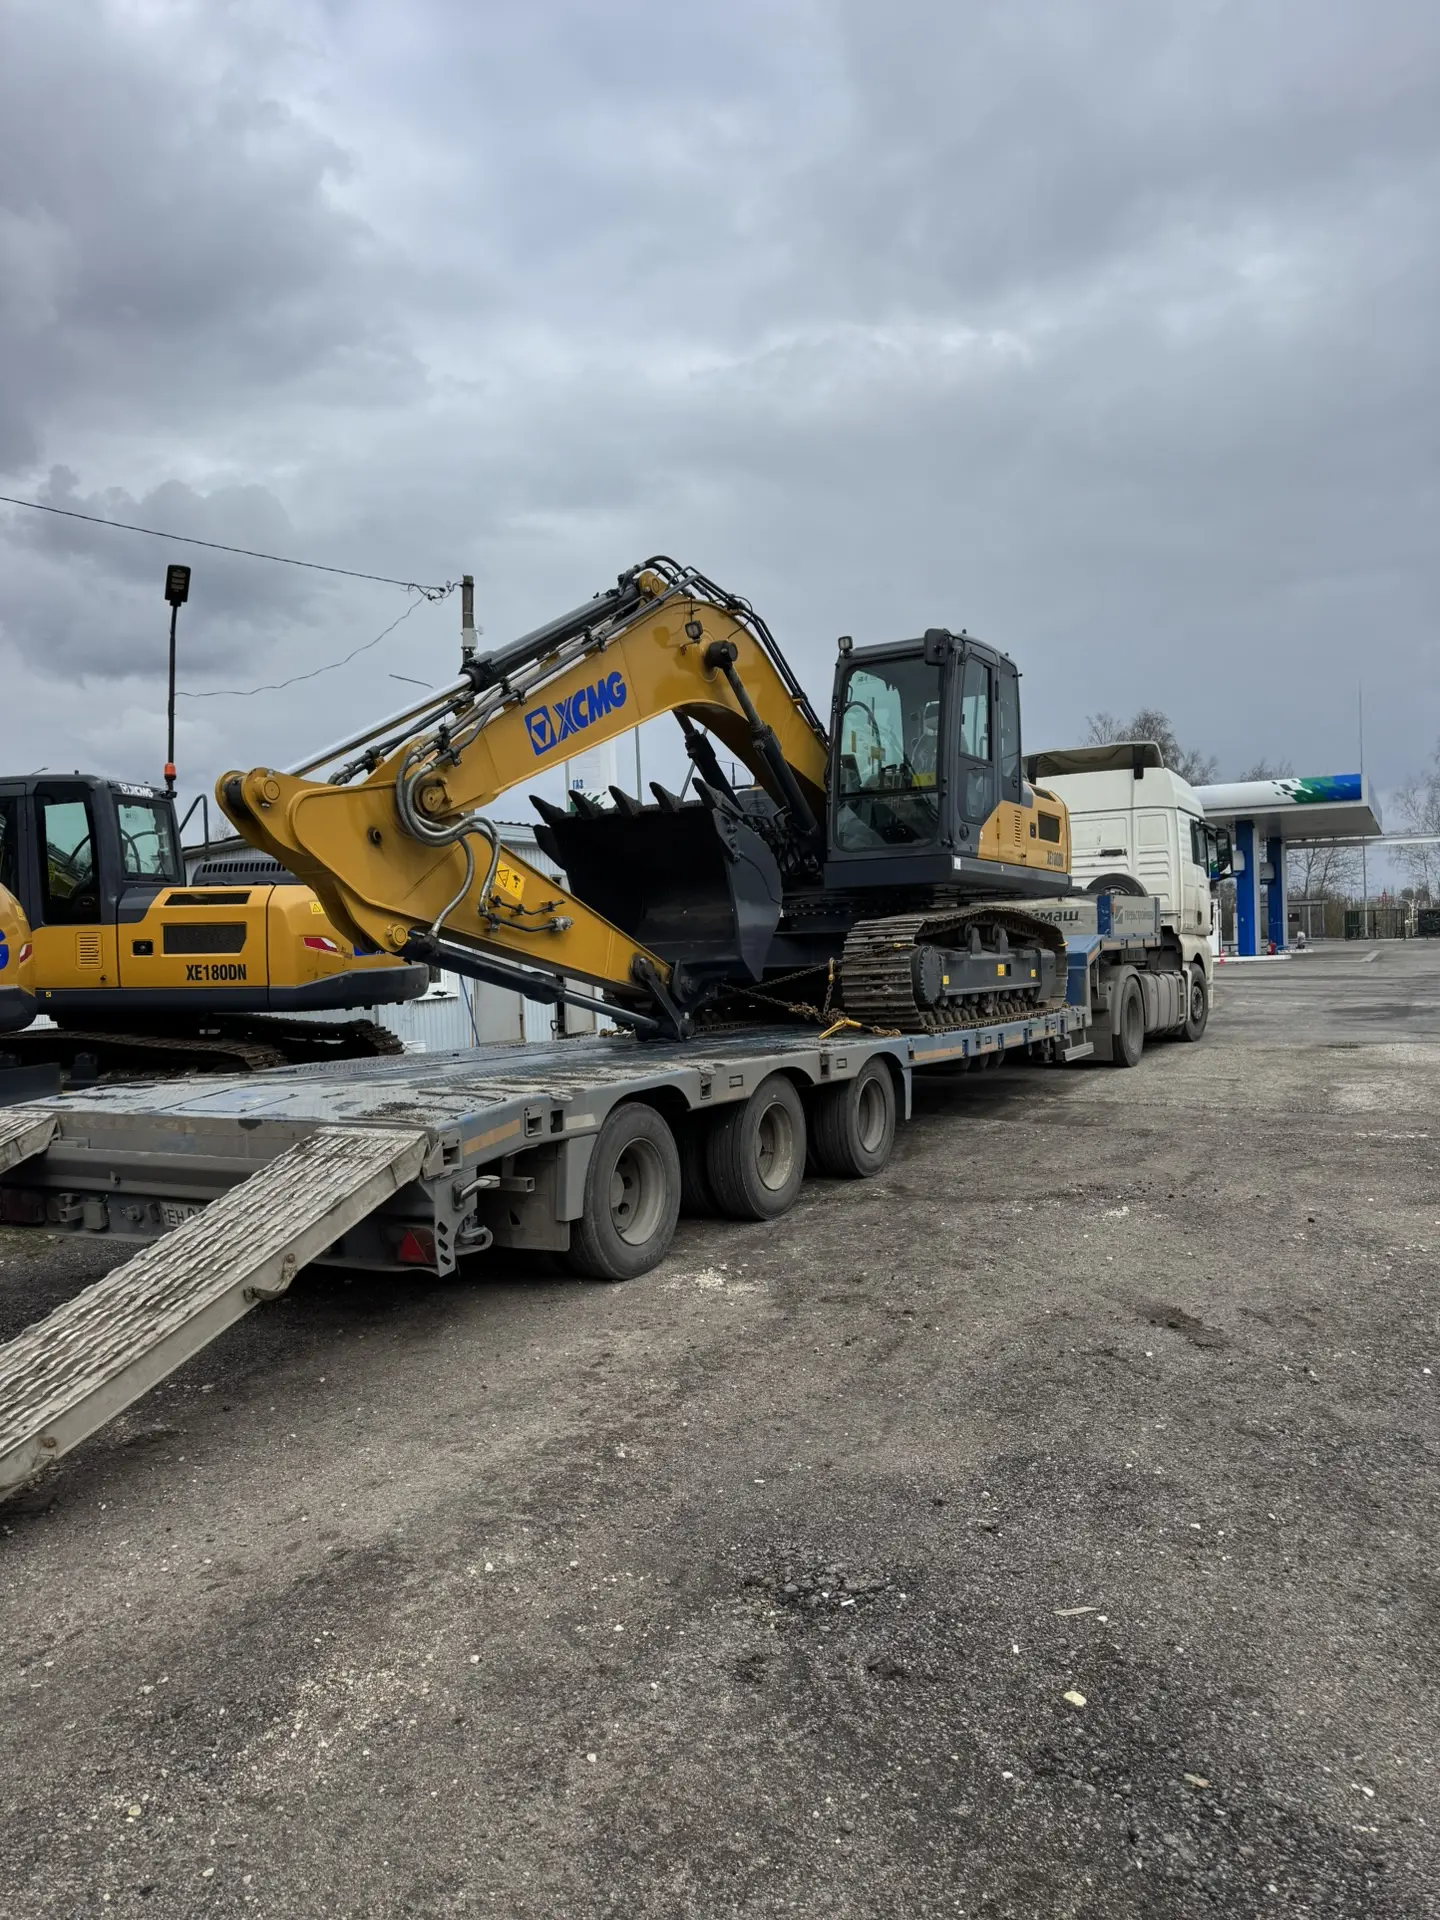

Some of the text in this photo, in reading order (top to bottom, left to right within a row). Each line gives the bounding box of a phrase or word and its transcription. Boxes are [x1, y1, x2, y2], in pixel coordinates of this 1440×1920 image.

[552, 671, 627, 743] XCMG
[129, 785, 154, 798] XCMG
[185, 963, 247, 981] XE180DN
